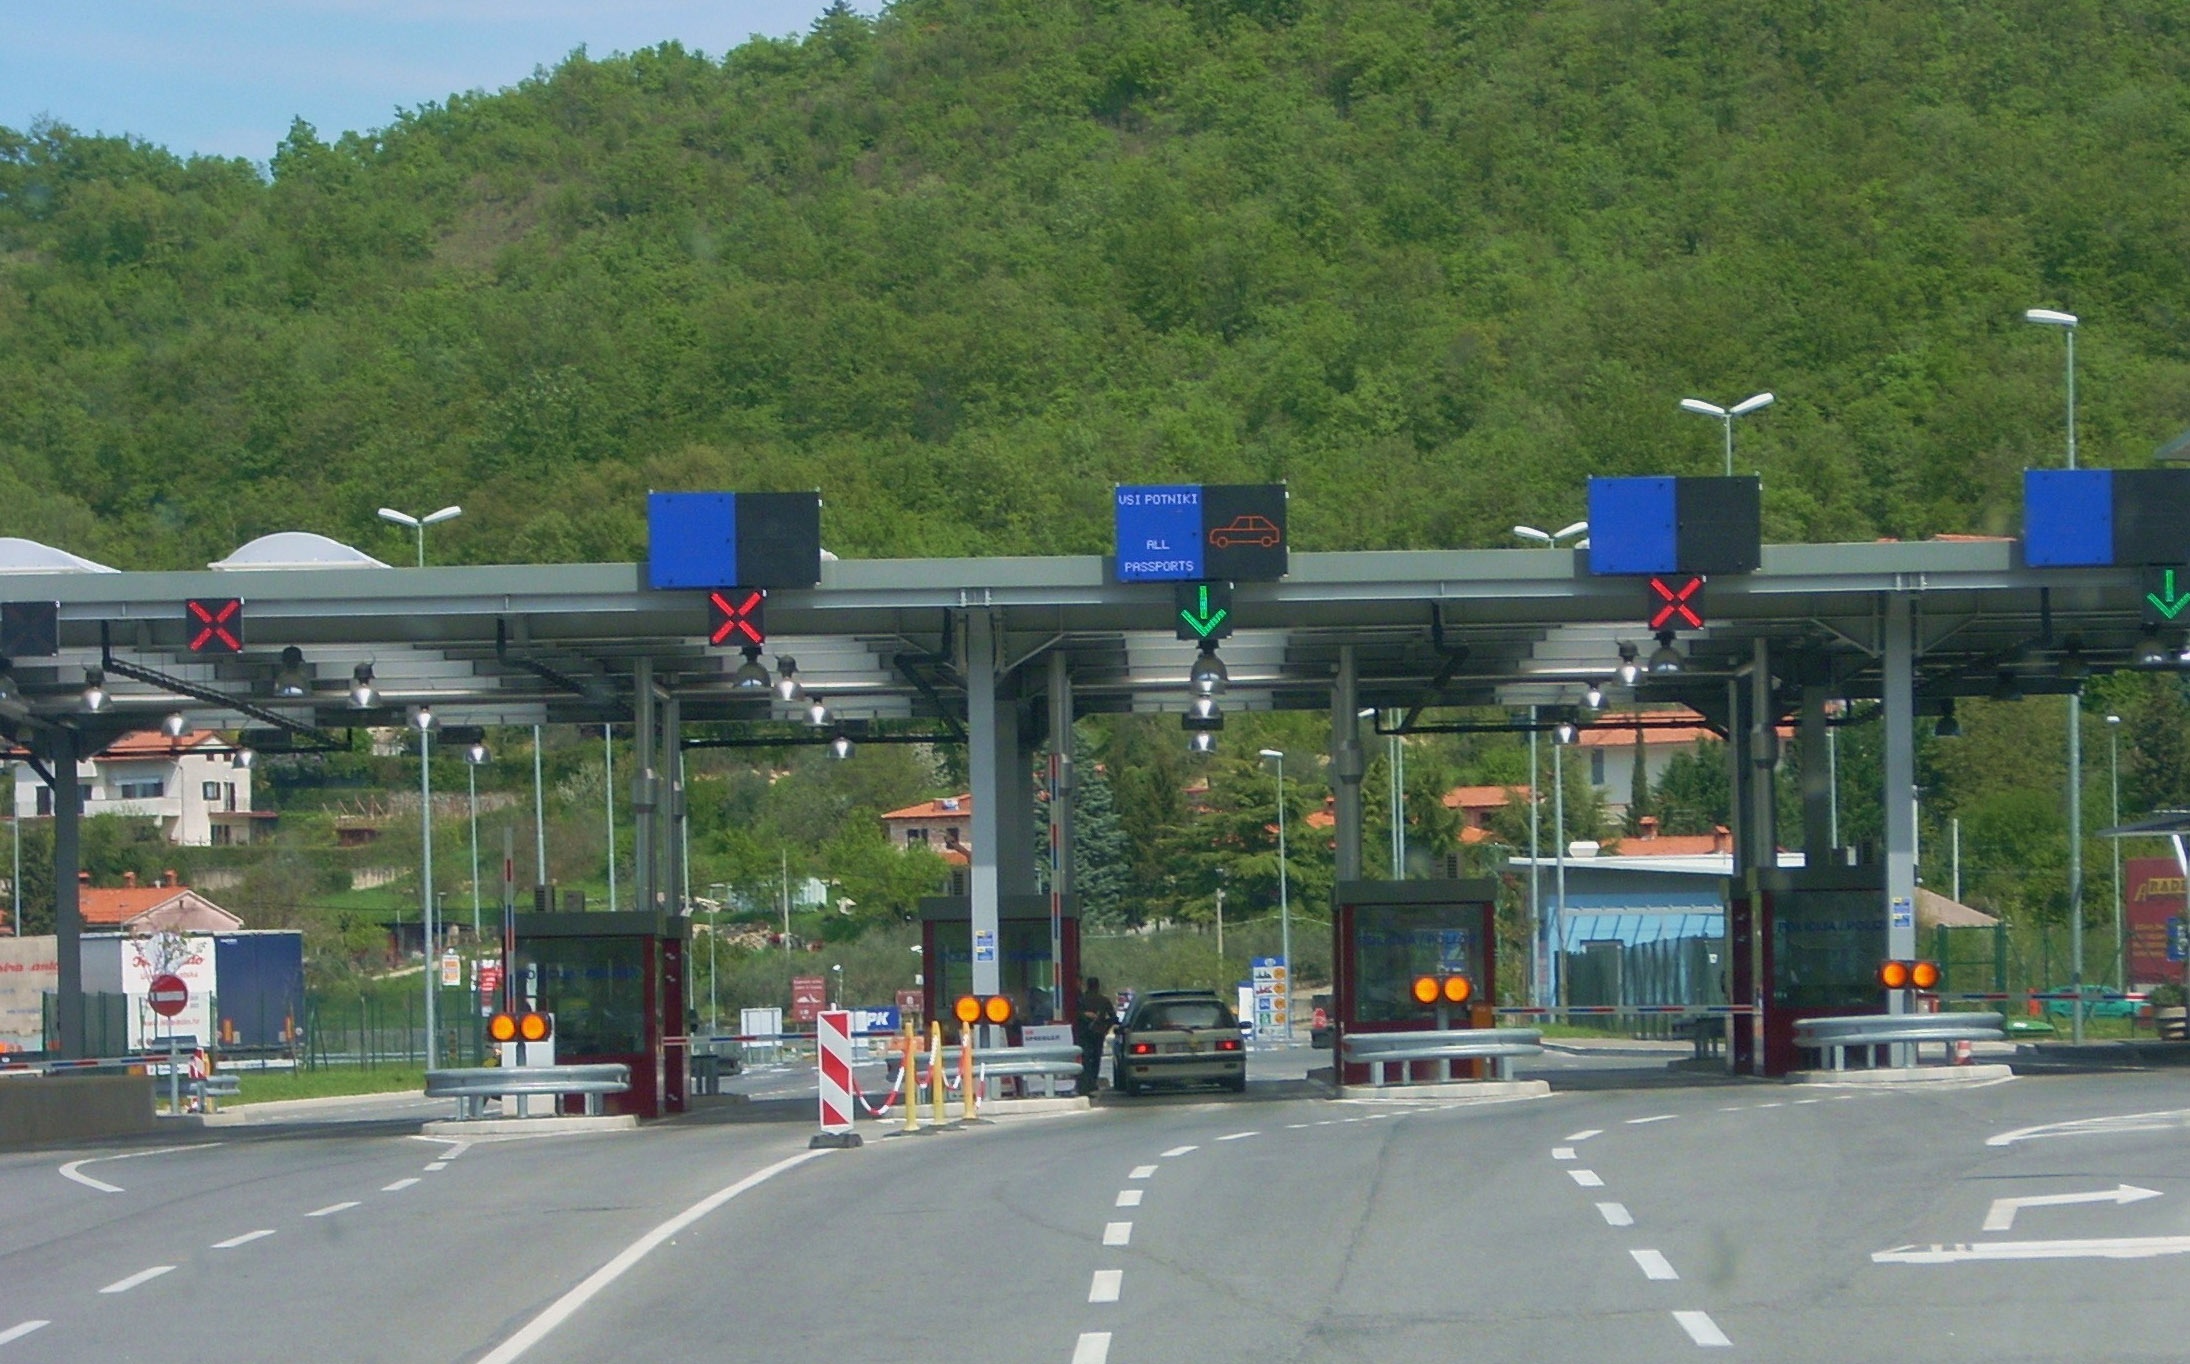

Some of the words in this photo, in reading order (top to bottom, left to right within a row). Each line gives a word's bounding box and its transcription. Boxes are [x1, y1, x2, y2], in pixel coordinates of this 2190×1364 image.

[1144, 493, 1198, 505] POTNIKI
[1146, 539, 1170, 550] ALL
[1124, 559, 1194, 572] PASSPORTS
